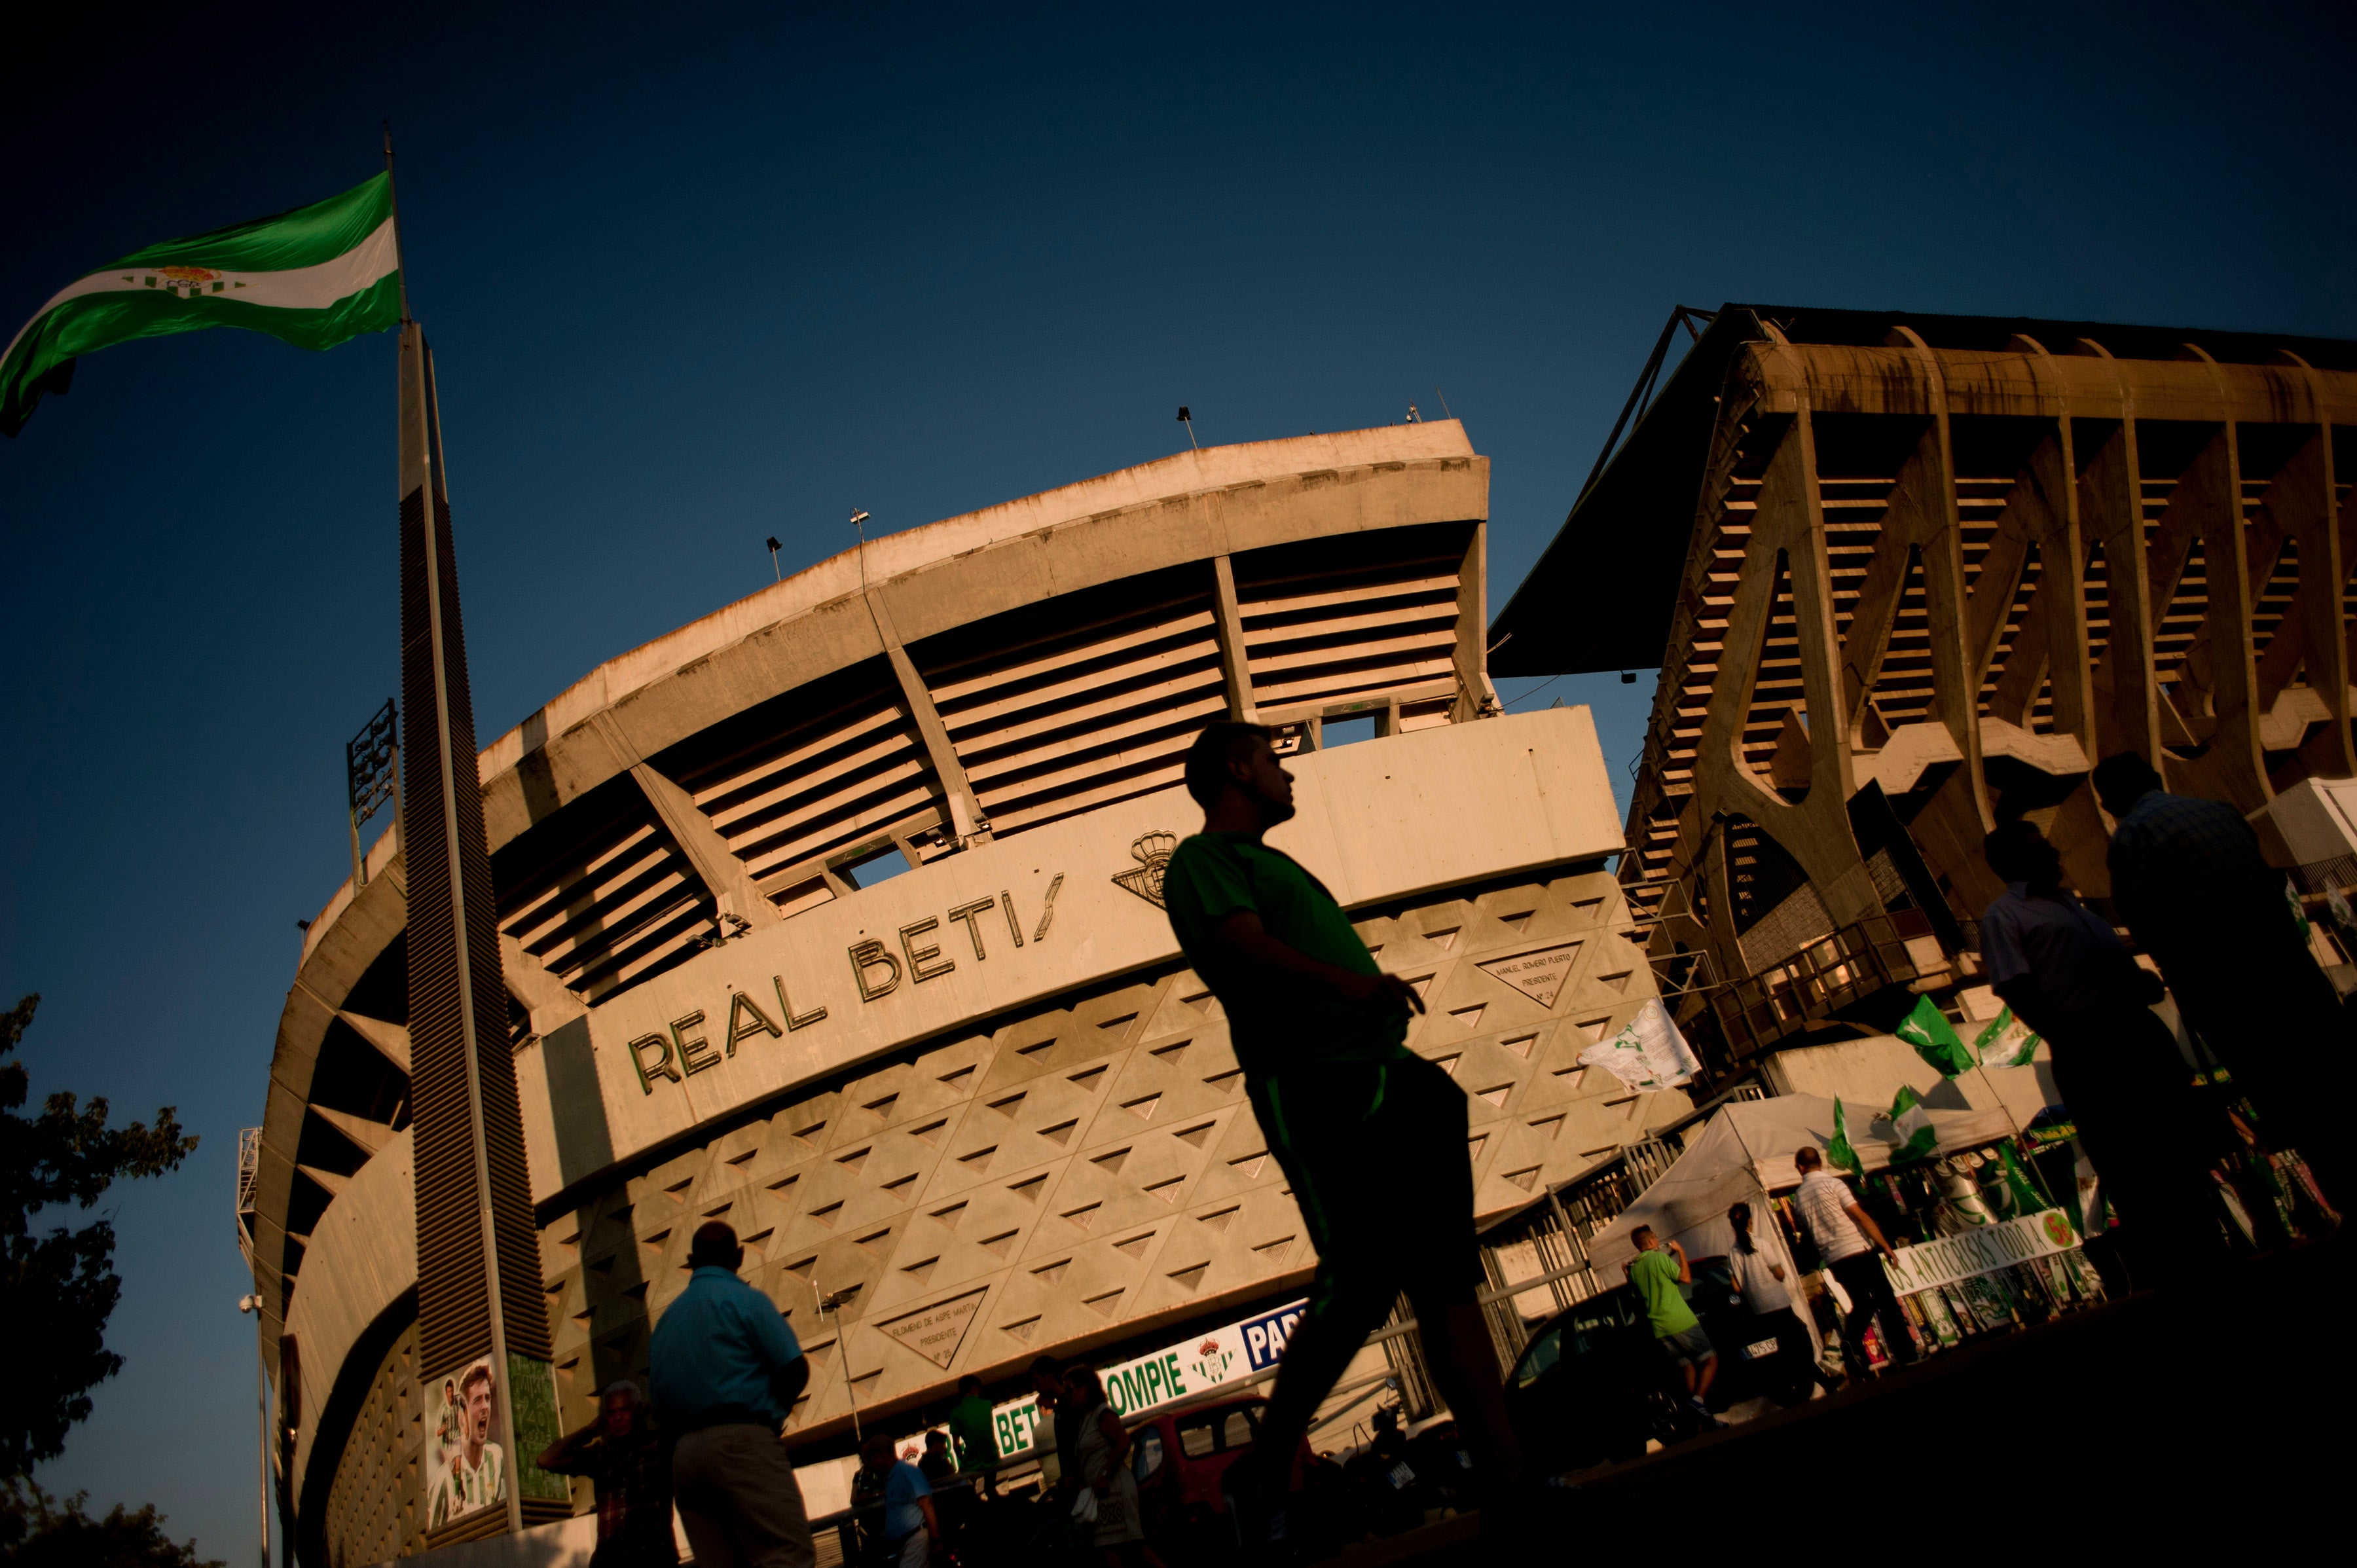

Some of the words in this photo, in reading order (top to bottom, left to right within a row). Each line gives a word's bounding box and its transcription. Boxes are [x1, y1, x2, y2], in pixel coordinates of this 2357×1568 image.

[1495, 964, 1521, 976] MANUEL
[1522, 958, 1547, 970] ROMERO
[1548, 953, 1571, 964] PUERTO
[627, 974, 828, 1096] REAL
[847, 872, 1065, 1004] BETIS
[1522, 972, 1557, 987] PRESIDENTE
[1908, 1233, 1997, 1285] ANTICRISIS
[1987, 1222, 2036, 1261] TODO
[2028, 1219, 2049, 1252] A
[892, 1320, 923, 1338] FILOMENO
[924, 1316, 932, 1327] DE
[935, 1309, 951, 1324] ASPE
[919, 1326, 957, 1347] PRESIDENTE
[996, 1400, 1043, 1456] BET
[1107, 1351, 1187, 1416] OMPIE
